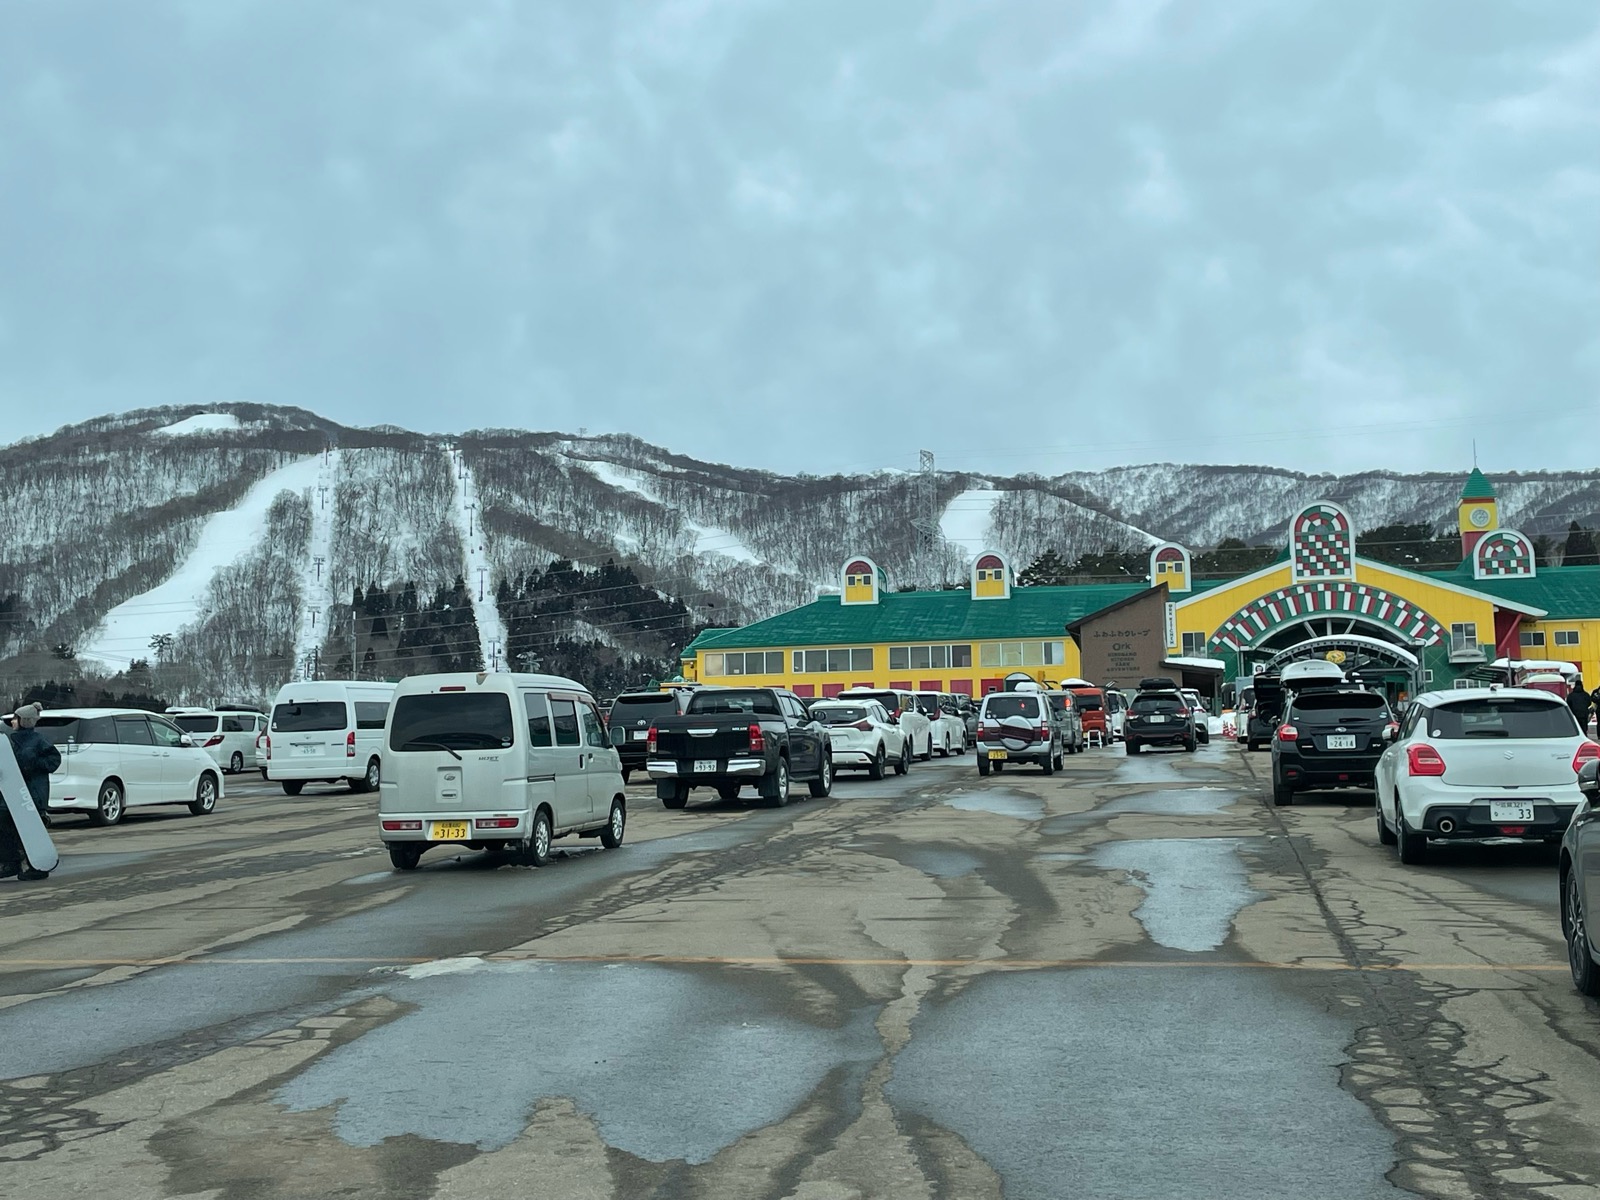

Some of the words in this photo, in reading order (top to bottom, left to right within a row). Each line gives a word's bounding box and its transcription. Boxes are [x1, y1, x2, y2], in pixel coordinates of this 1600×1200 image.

[1093, 629, 1151, 638] ふわふわクレープ
[1518, 808, 1532, 820] 33
[440, 828, 466, 839] 31-33
